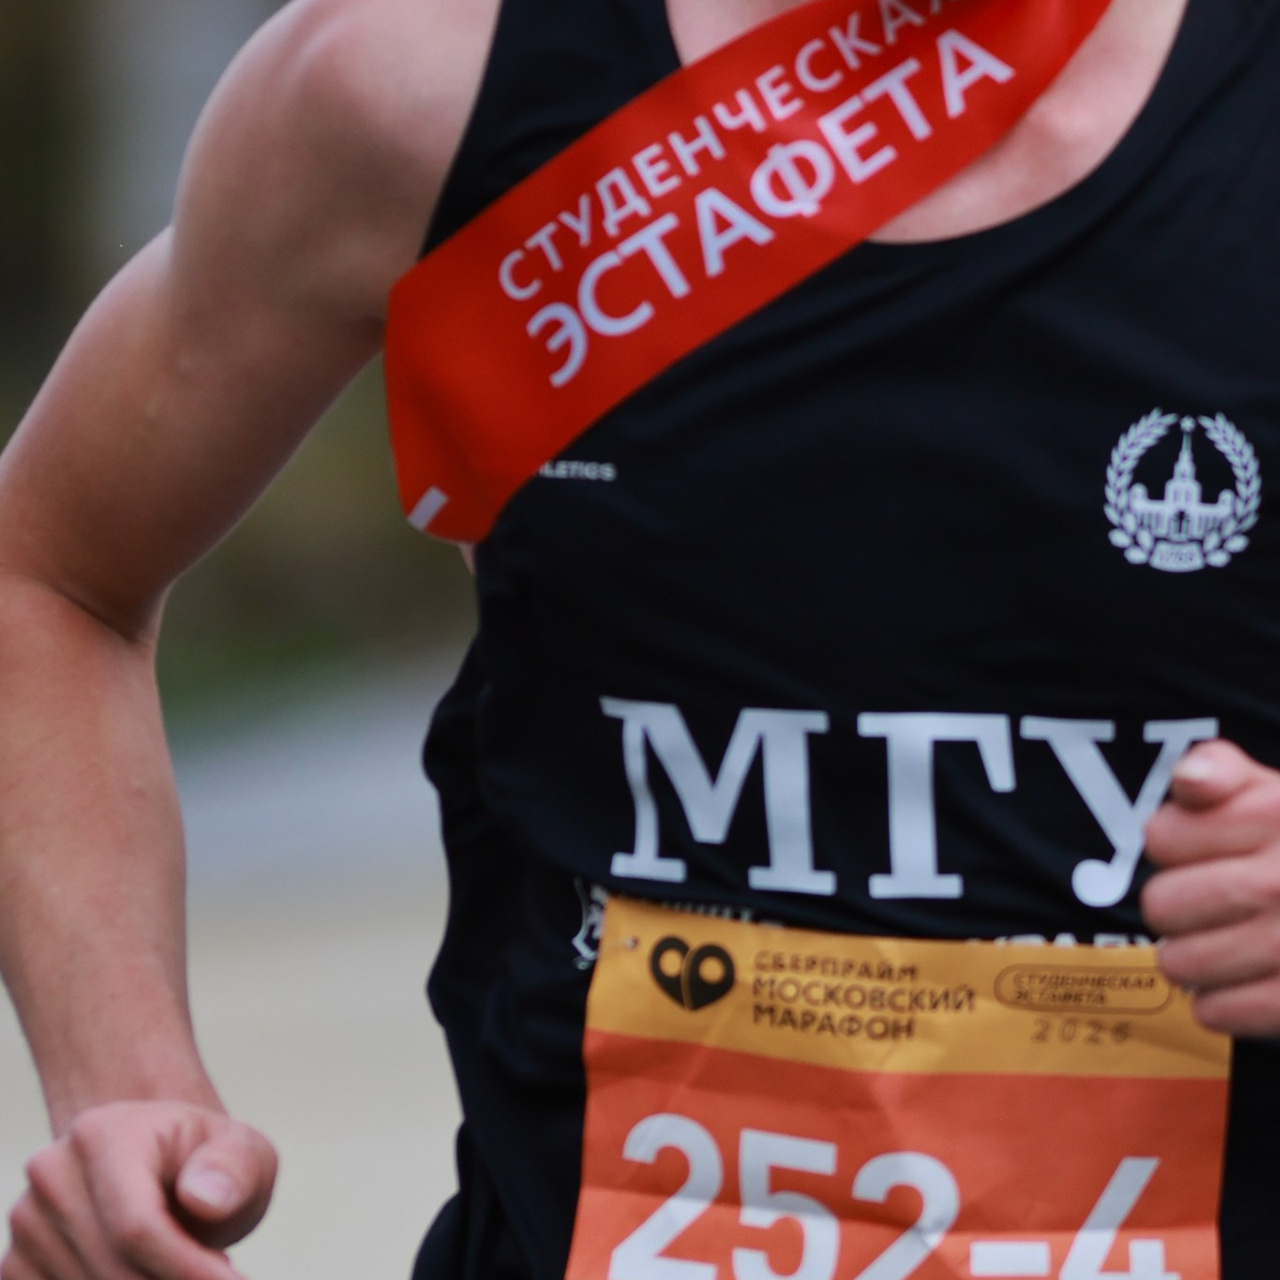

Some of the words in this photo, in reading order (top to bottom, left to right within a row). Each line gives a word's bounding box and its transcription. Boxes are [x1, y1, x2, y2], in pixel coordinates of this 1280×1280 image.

[526, 28, 1015, 388] ЭСТАФЕТА
[536, 461, 617, 482] LETICS
[600, 696, 1218, 908] МГУ
[754, 949, 918, 981] СБЕРПРАЙМ
[753, 976, 976, 1013] МОСКОВСКИЙ
[753, 1003, 915, 1041] МАРАФОН
